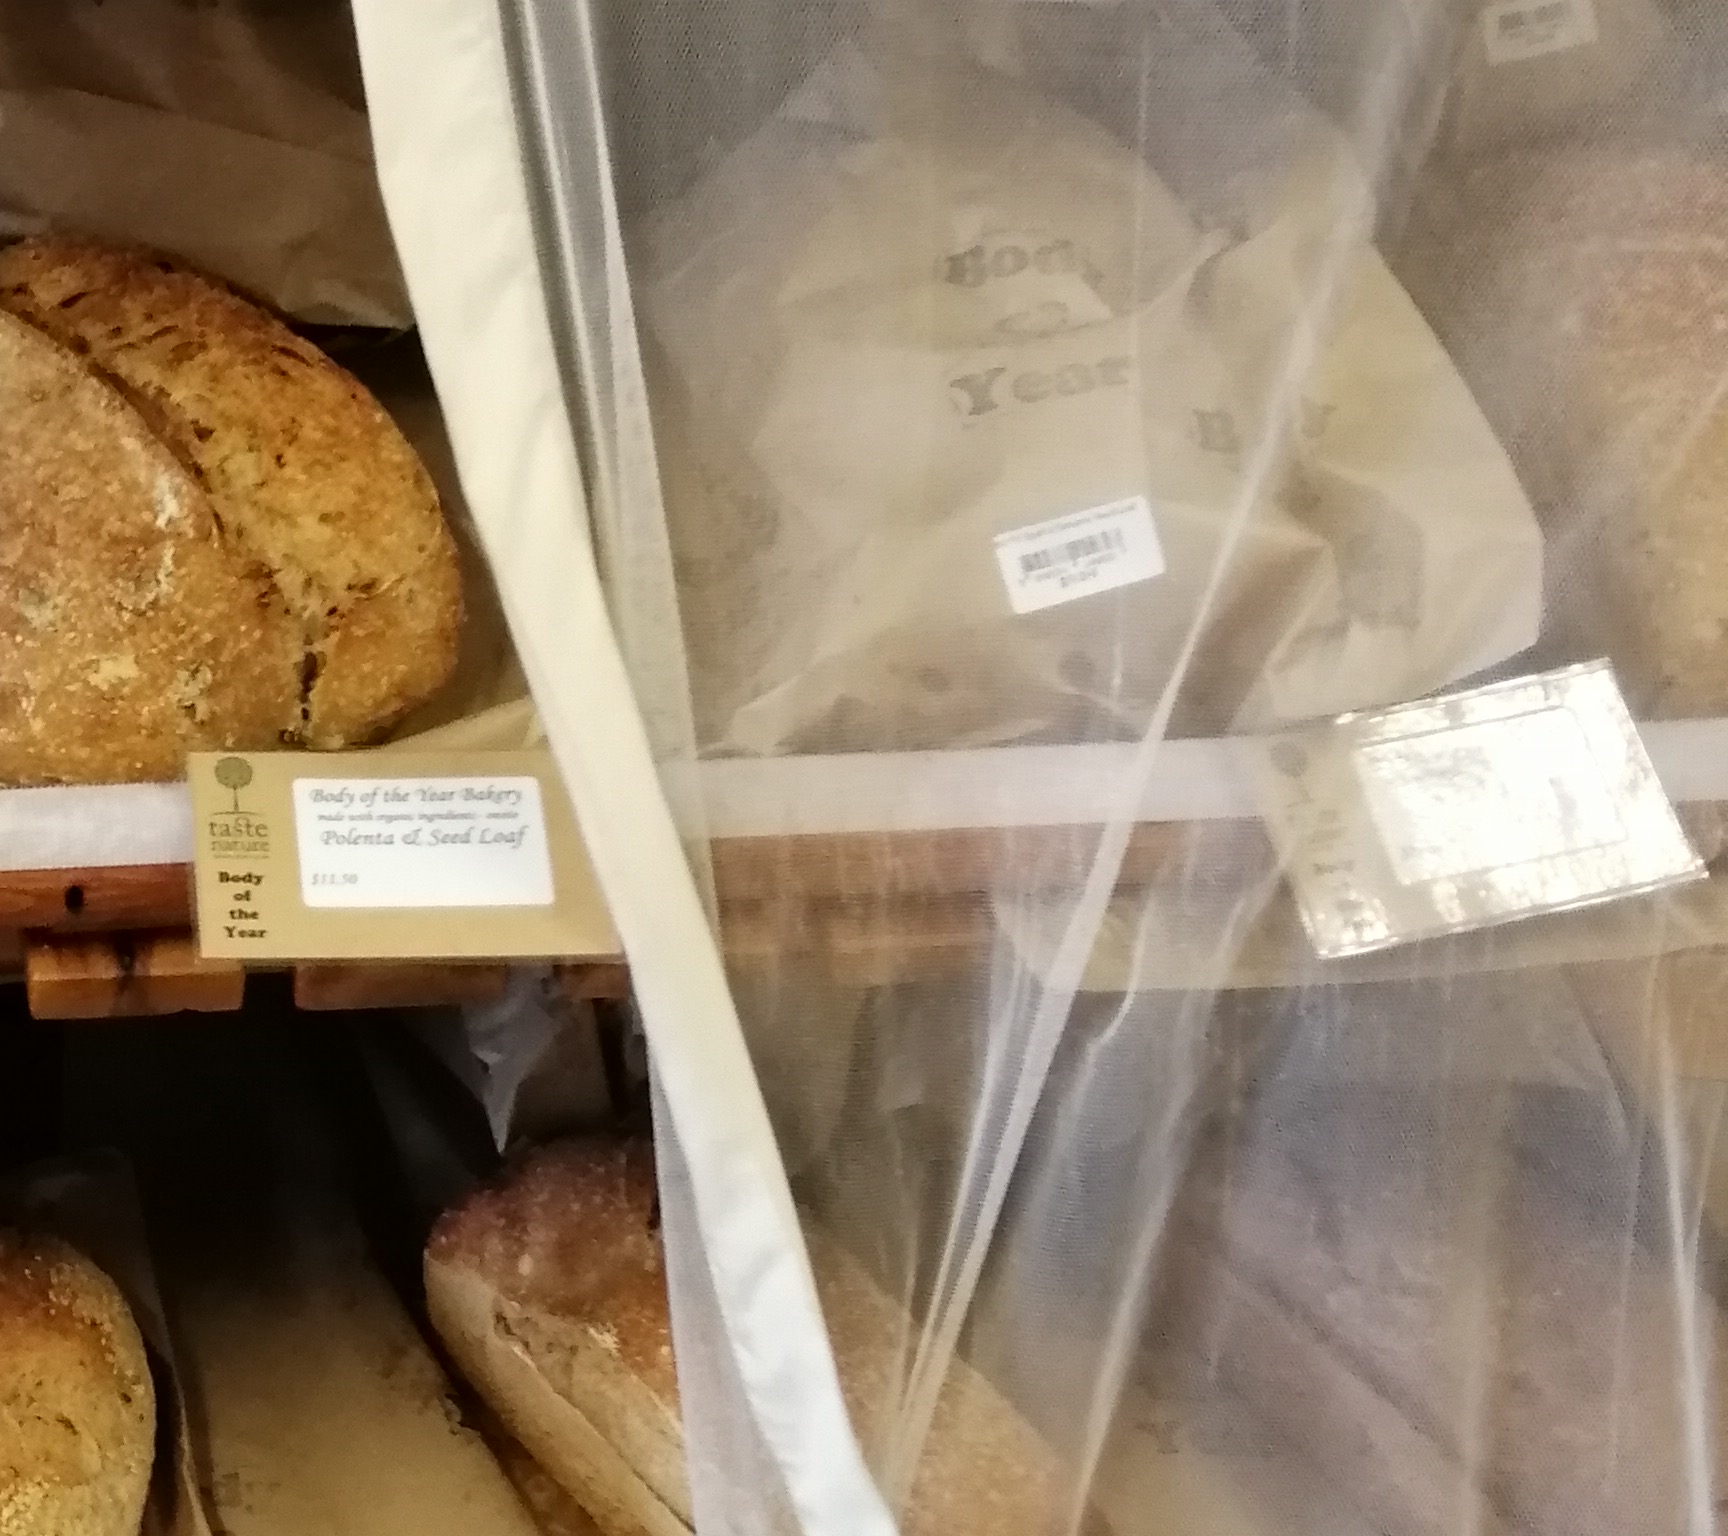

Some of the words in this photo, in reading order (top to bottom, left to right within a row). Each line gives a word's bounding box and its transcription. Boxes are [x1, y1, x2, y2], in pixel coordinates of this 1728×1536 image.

[309, 788, 354, 807] Body
[360, 789, 378, 807] of
[384, 788, 410, 802] the
[415, 787, 455, 802] Year
[461, 786, 522, 805] Bakery
[321, 828, 394, 845] Polenta
[428, 827, 475, 845] Seed
[478, 825, 529, 849] Loaf
[218, 871, 263, 886] Body
[233, 890, 251, 901] of
[229, 908, 259, 920] the
[224, 925, 267, 938] Year
